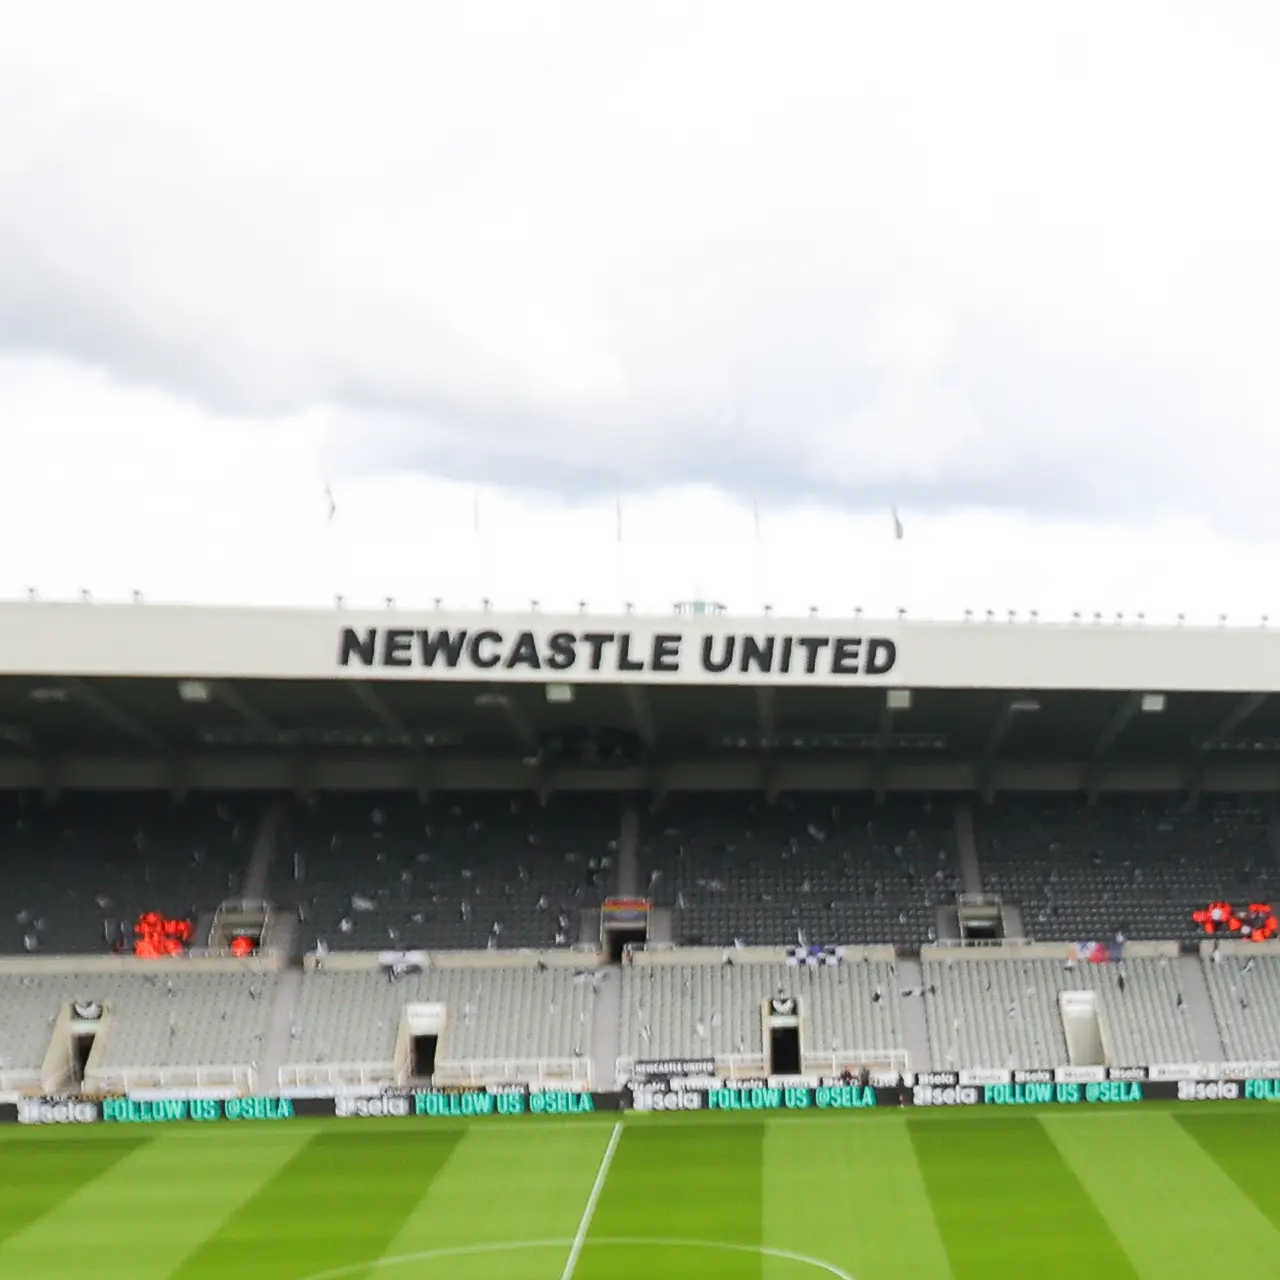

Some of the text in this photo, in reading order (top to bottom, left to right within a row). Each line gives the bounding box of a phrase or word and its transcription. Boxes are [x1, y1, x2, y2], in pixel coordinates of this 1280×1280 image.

[339, 626, 898, 675] NEWCASTLE UNITED
[415, 1093, 494, 1116] FOLLOW
[497, 1093, 524, 1115] US
[708, 1087, 782, 1109] FOLLOW
[784, 1087, 811, 1108] US
[984, 1083, 1054, 1104] FOLLOW
[1056, 1082, 1081, 1103] US
[103, 1098, 187, 1122] FOLLOW
[190, 1097, 220, 1121] US
